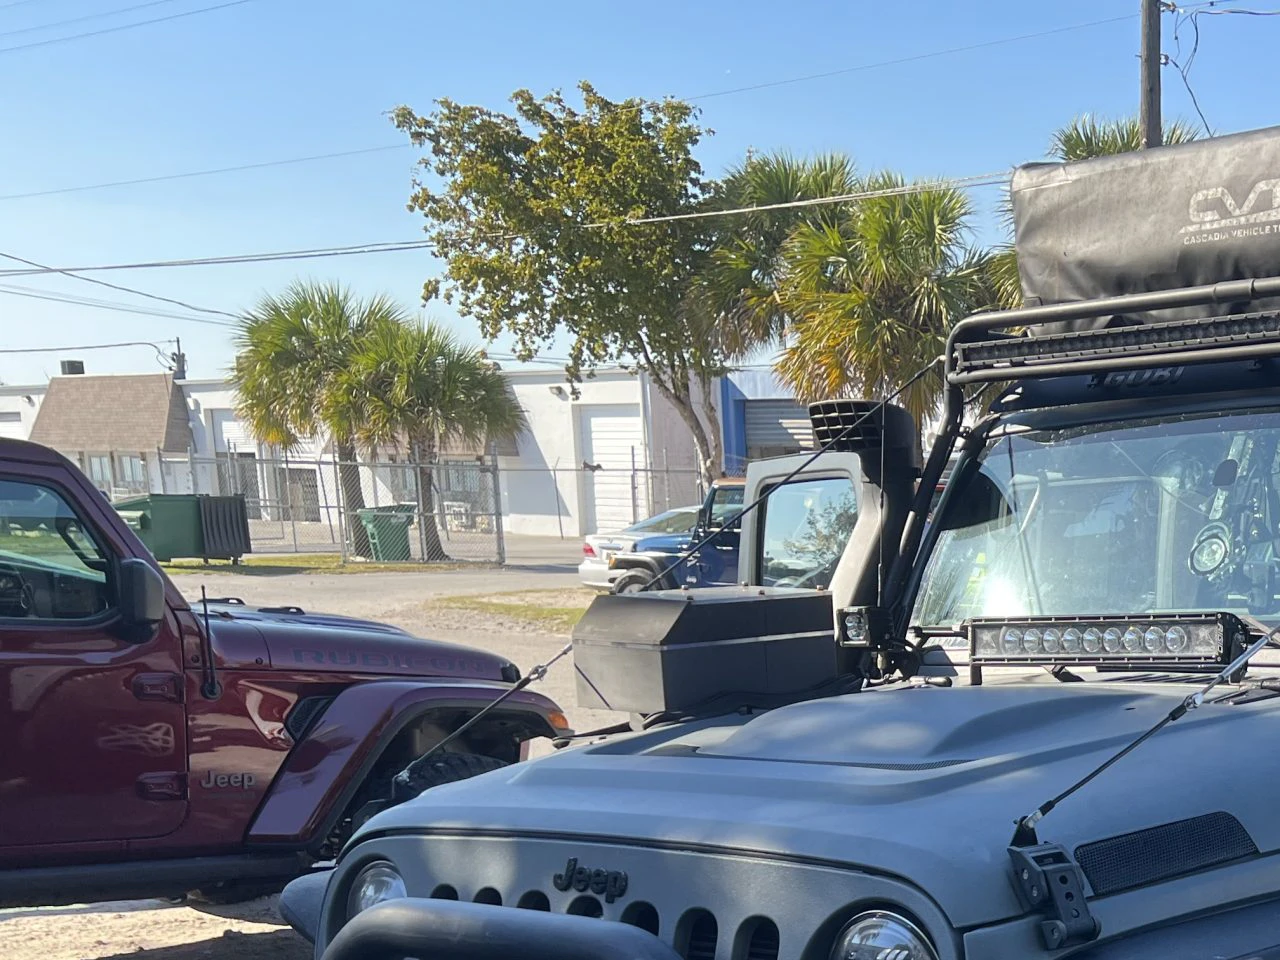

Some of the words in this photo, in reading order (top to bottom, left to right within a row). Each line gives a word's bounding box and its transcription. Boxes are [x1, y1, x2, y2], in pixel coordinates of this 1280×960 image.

[1183, 232, 1229, 246] CASCADIA
[1231, 225, 1271, 239] VEHICLE
[201, 769, 257, 789] Jeep
[553, 857, 628, 904] Jeep
